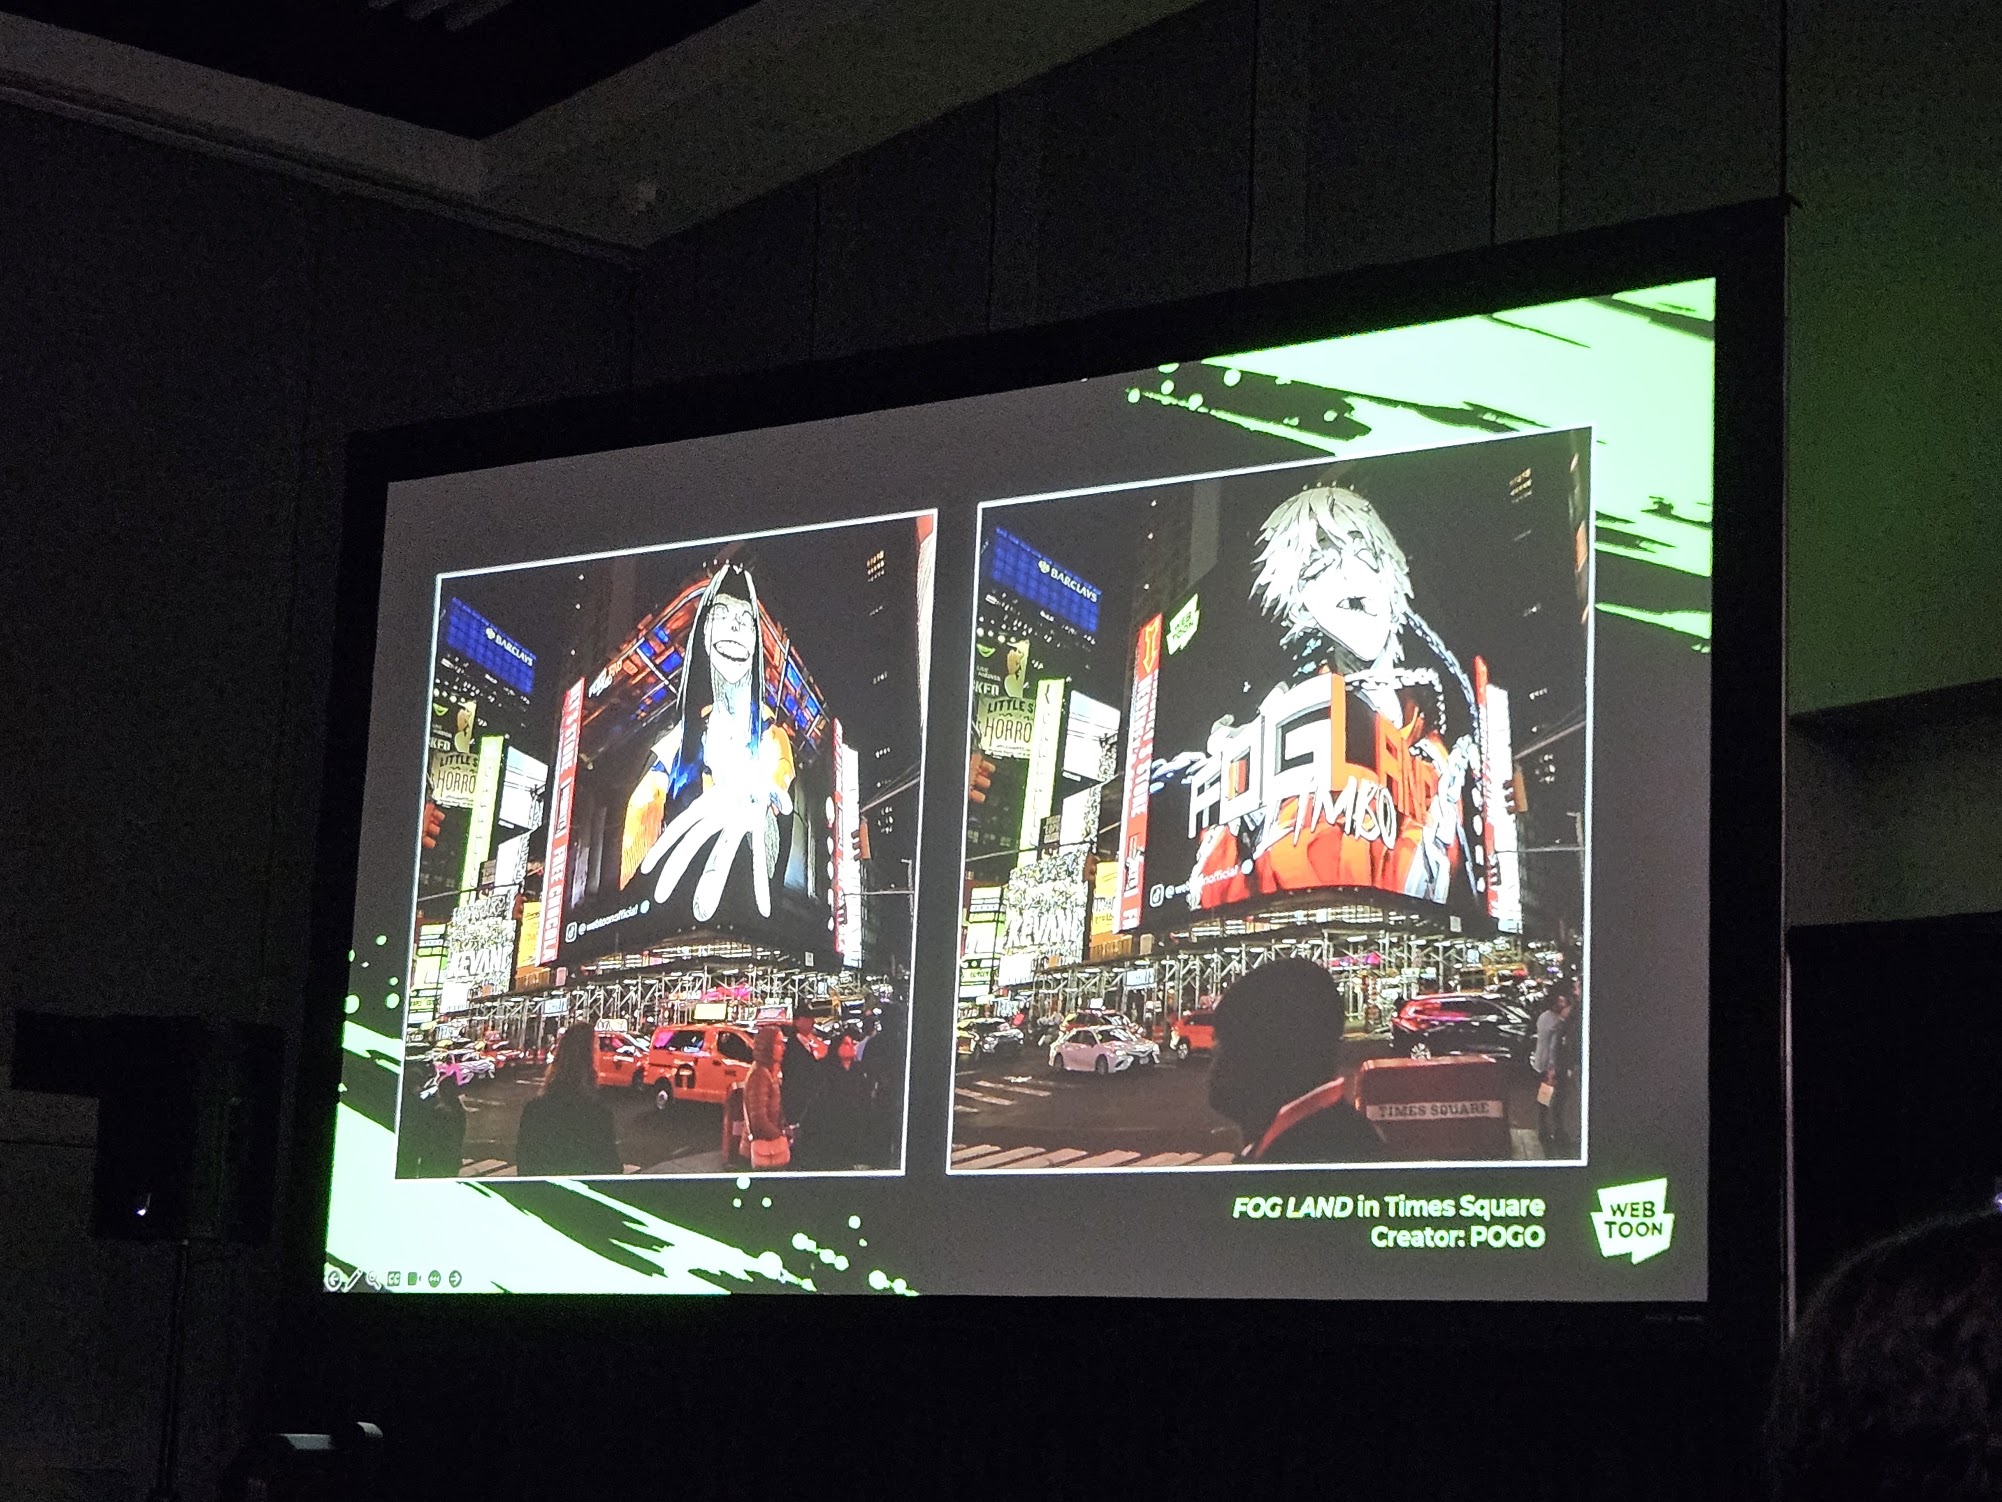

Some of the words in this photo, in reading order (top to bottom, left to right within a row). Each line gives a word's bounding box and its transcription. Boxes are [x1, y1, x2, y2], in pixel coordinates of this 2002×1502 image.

[1050, 567, 1098, 603] BARCLAYS
[495, 633, 534, 667] BARCLAYS
[987, 699, 1026, 714] LITTLE
[984, 716, 1033, 747] HORRO
[439, 754, 471, 768] LITTLE
[1187, 672, 1333, 839] FOG
[436, 769, 476, 798] HORRO
[1251, 775, 1398, 859] LIMBO
[1379, 1104, 1427, 1119] TIMES
[1431, 1101, 1490, 1117] SQUARE
[1232, 1196, 1284, 1219] FOG
[1285, 1196, 1354, 1219] LAND
[1357, 1194, 1381, 1218] in
[1384, 1194, 1456, 1218] Times
[1459, 1194, 1546, 1221] Square
[1610, 1200, 1656, 1218] WEB
[1371, 1225, 1466, 1248] Creator:
[1470, 1225, 1546, 1248] POGO
[1603, 1220, 1663, 1239] TOON
